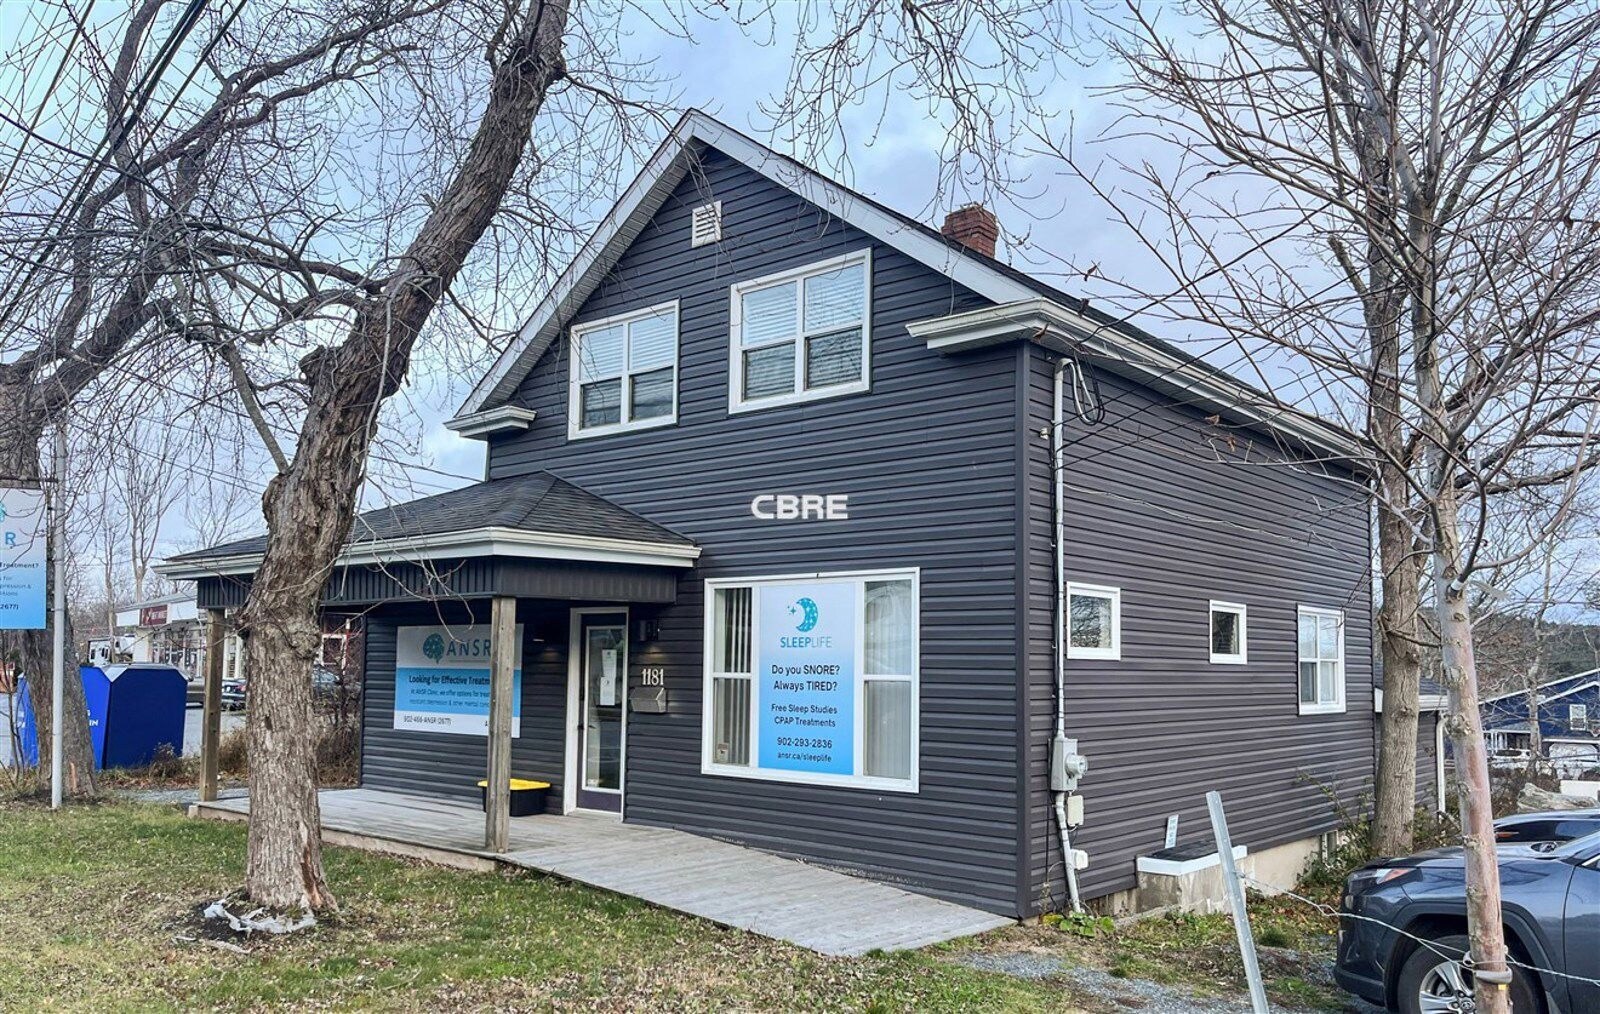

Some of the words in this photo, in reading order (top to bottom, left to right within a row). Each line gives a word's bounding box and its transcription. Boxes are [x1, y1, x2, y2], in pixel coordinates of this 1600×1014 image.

[446, 639, 491, 657] ANSR
[771, 664, 784, 675] Do
[786, 666, 801, 677] you
[803, 664, 840, 676] SNORE?
[409, 675, 431, 686] Looking
[432, 675, 441, 684] for
[441, 676, 468, 685] Effective
[641, 668, 664, 686] 1181
[774, 681, 804, 692] Always
[806, 681, 838, 692] TIRED?
[771, 703, 787, 712] Free
[788, 704, 809, 714] Sleep
[810, 704, 837, 715] Studies
[774, 716, 794, 725] CPAP
[795, 717, 836, 728] Treatments
[777, 737, 832, 749] 902-293-2836
[778, 752, 832, 763] ansr.ca/sleeplife
